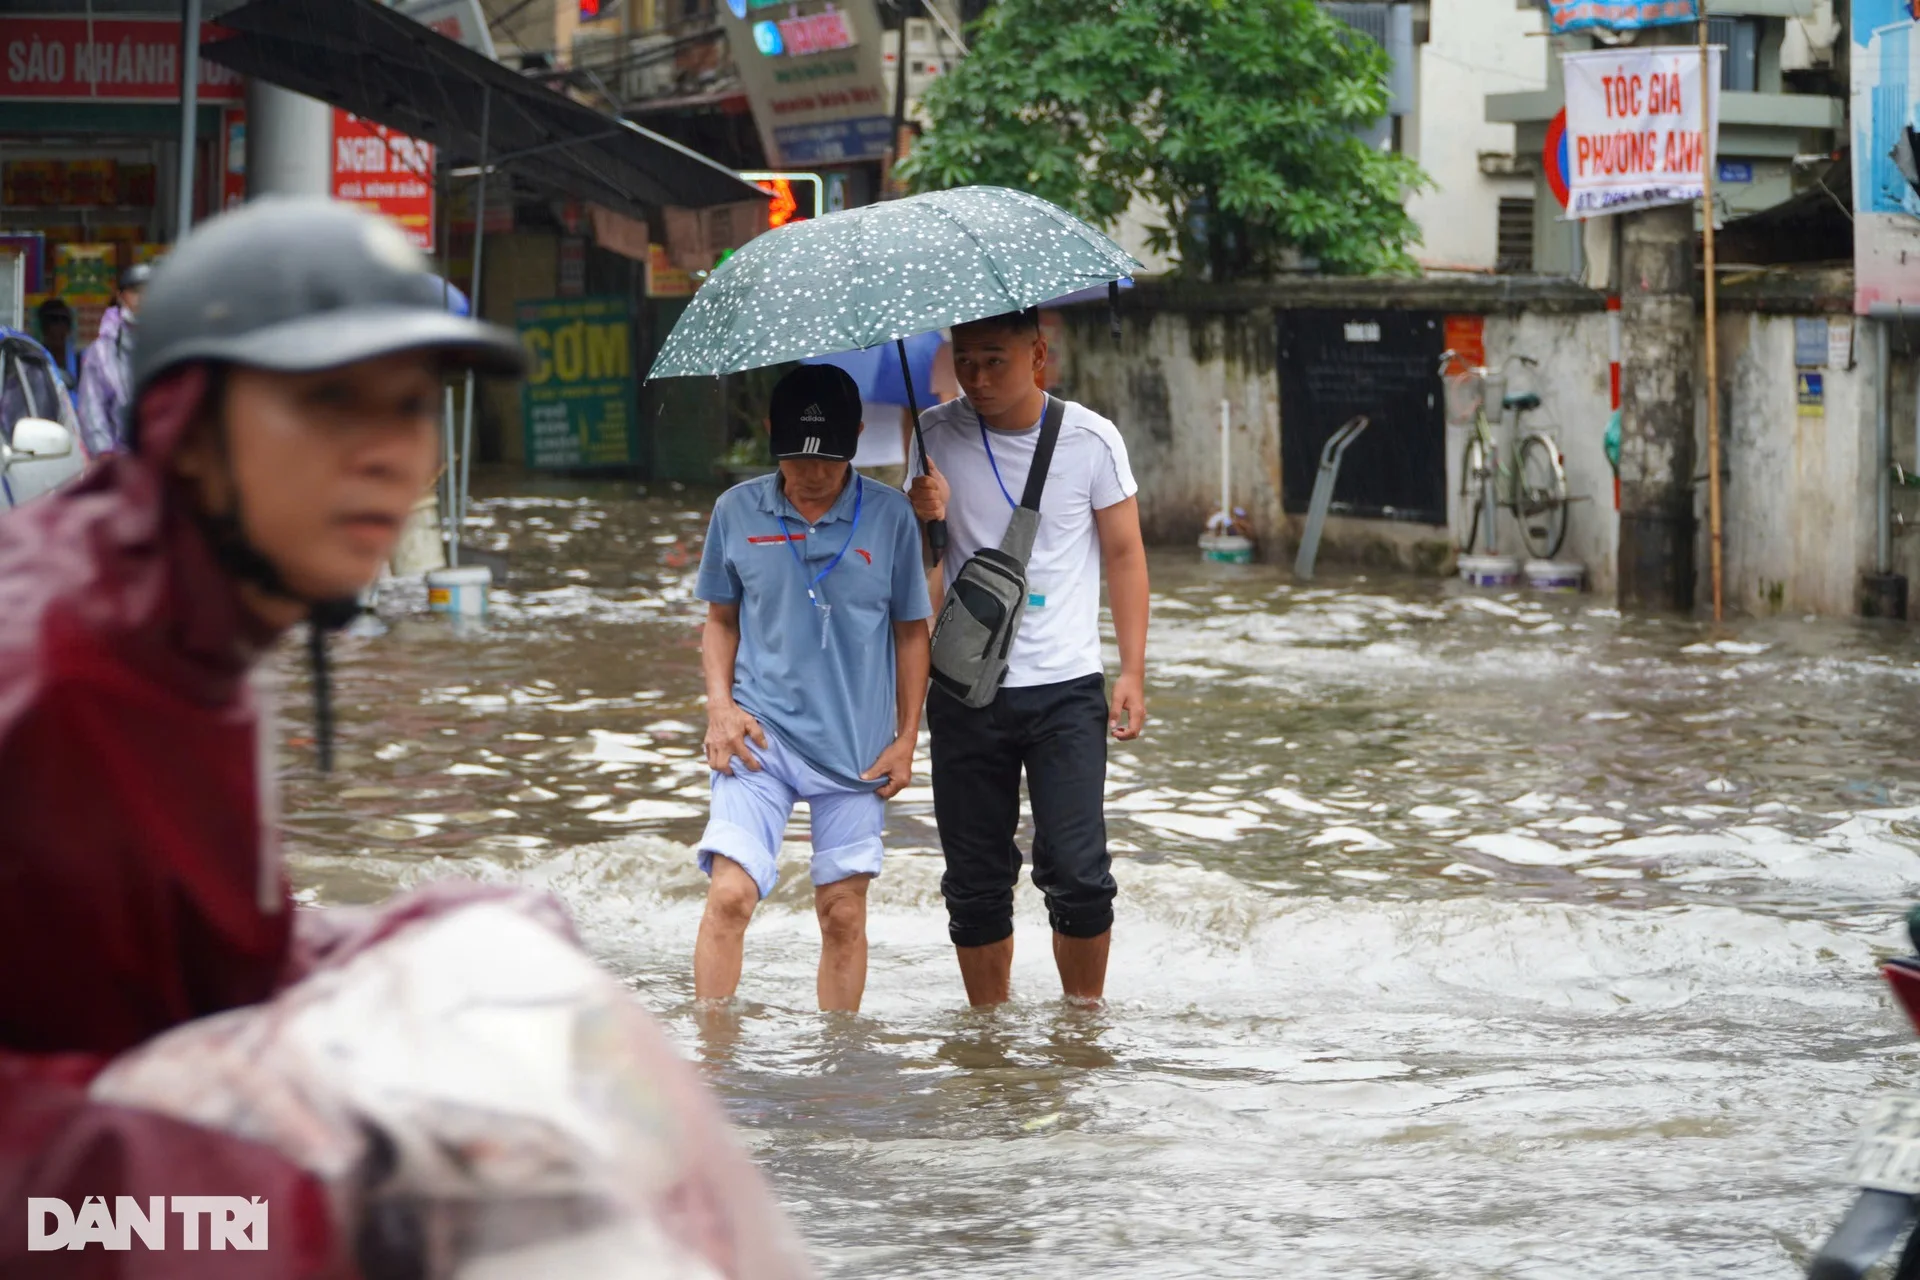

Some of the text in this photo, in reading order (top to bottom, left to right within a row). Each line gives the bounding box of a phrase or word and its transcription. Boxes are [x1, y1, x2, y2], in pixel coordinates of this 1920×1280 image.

[8, 33, 66, 83] SÀO
[74, 35, 176, 84] KHÁNH
[1576, 129, 1657, 176] PHƯƠNG
[521, 321, 629, 384] CƠM
